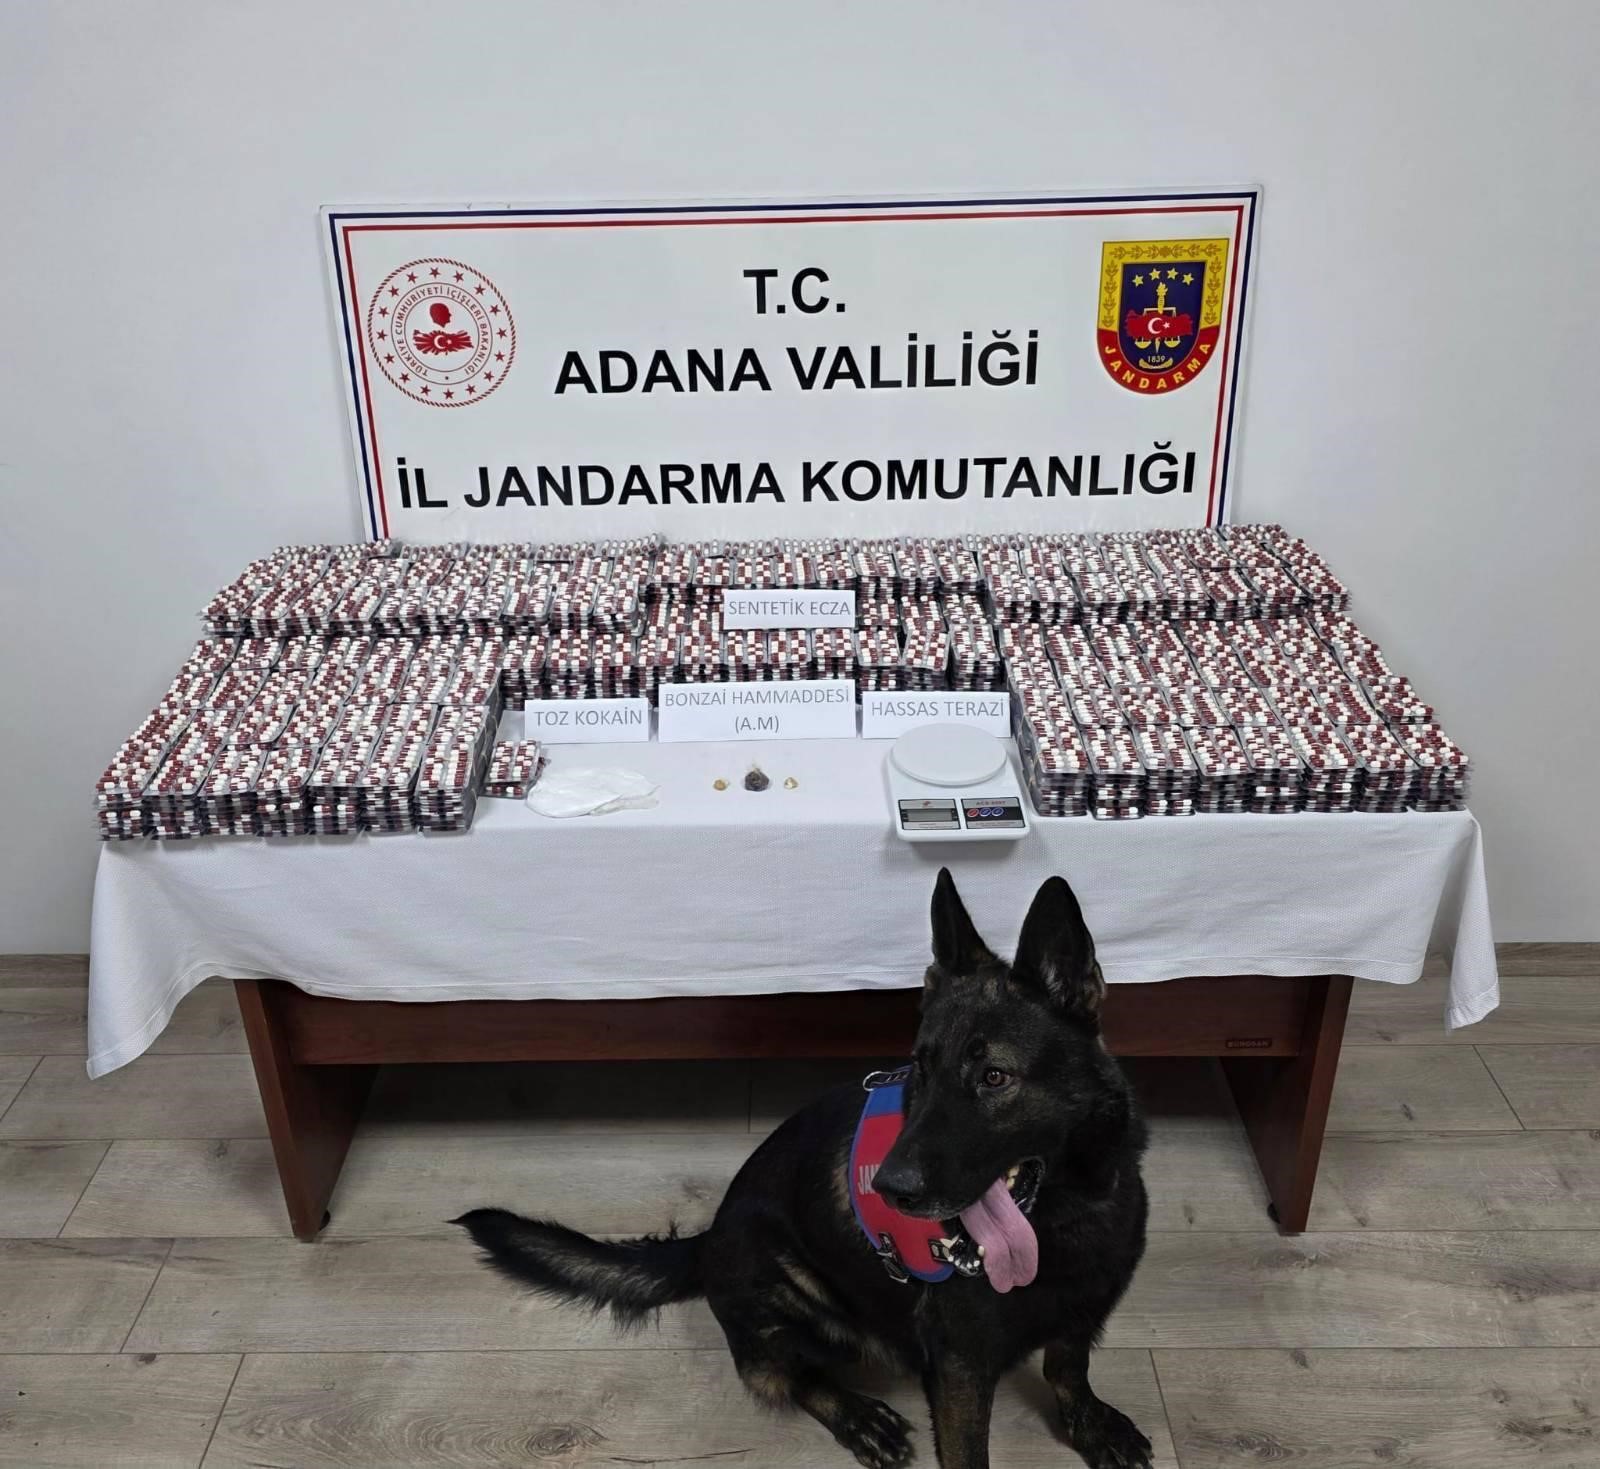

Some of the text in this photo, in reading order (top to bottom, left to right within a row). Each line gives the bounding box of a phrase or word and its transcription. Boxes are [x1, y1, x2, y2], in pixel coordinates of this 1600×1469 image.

[743, 267, 846, 315] T.C.
[395, 285, 443, 335] CUMHURİYETİ
[554, 329, 1039, 395] ADANA VALİLİĞİ
[1104, 343, 1211, 390] JANDARMA
[396, 440, 1196, 508] İL JANDARMA KOMUTANLIĞI
[728, 598, 851, 616] SENTETİK ECZA
[664, 685, 850, 707] BONZAİ HAMMADDESİ
[871, 697, 1004, 717] HASSAS TERAZİ
[534, 706, 643, 727] TOZ KOKAİN
[734, 715, 780, 734] (A.M)
